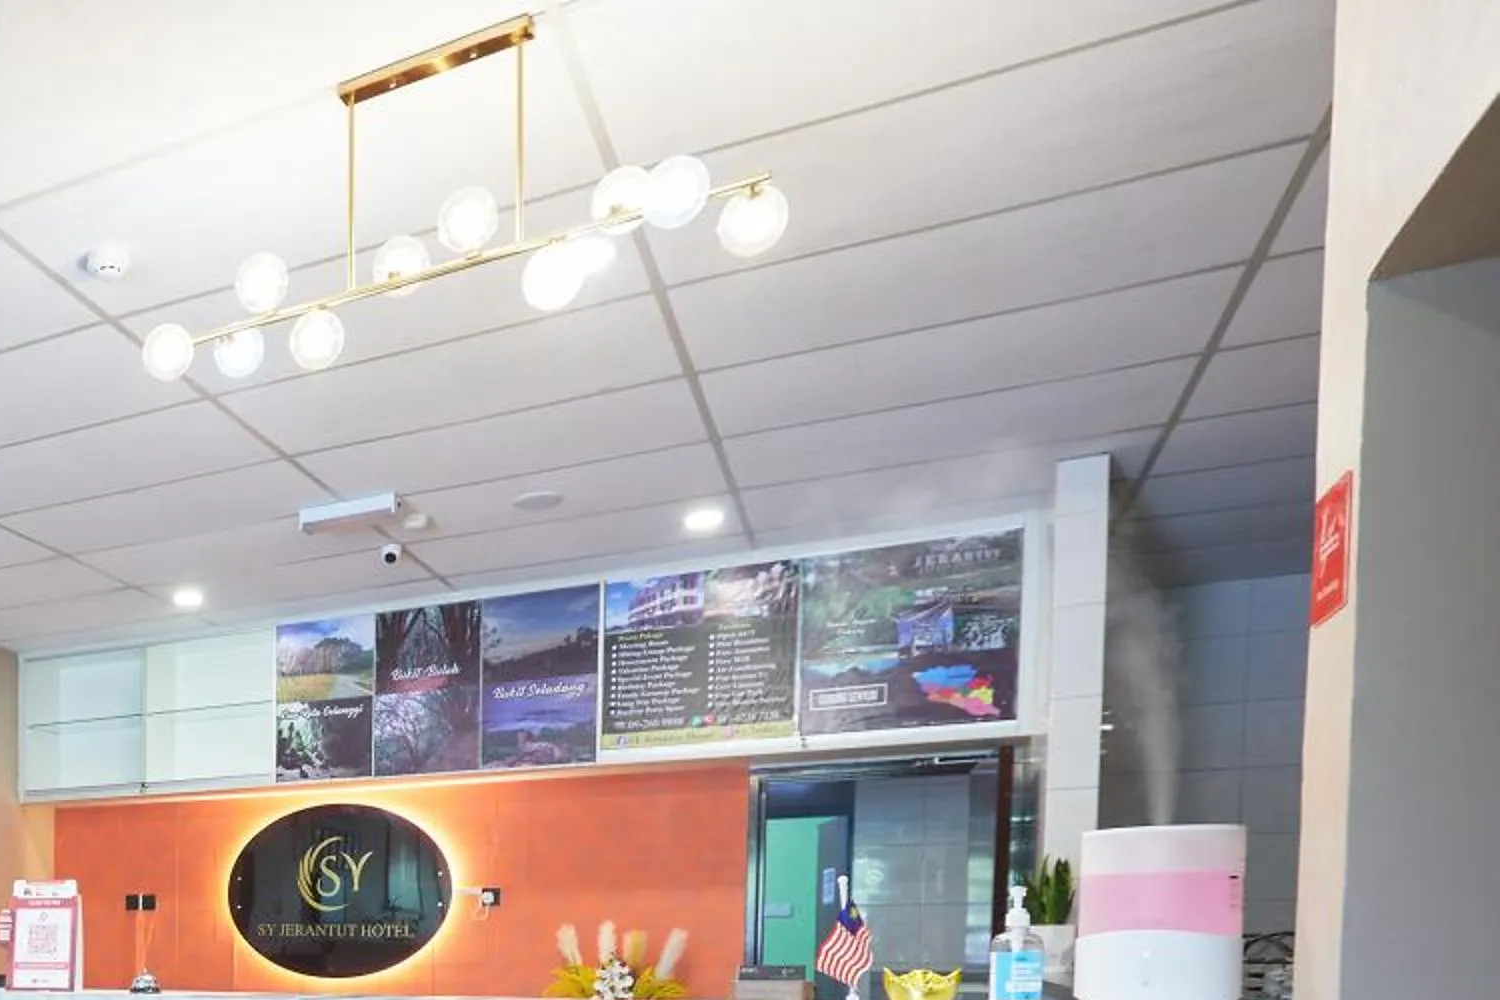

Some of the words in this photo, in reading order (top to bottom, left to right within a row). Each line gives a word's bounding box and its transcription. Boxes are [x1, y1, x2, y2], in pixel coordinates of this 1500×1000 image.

[493, 687, 526, 699] Bukit
[316, 850, 373, 898] SY
[257, 923, 276, 938] SY
[279, 923, 358, 938] JERANTUT
[361, 923, 415, 939] HOTEL
